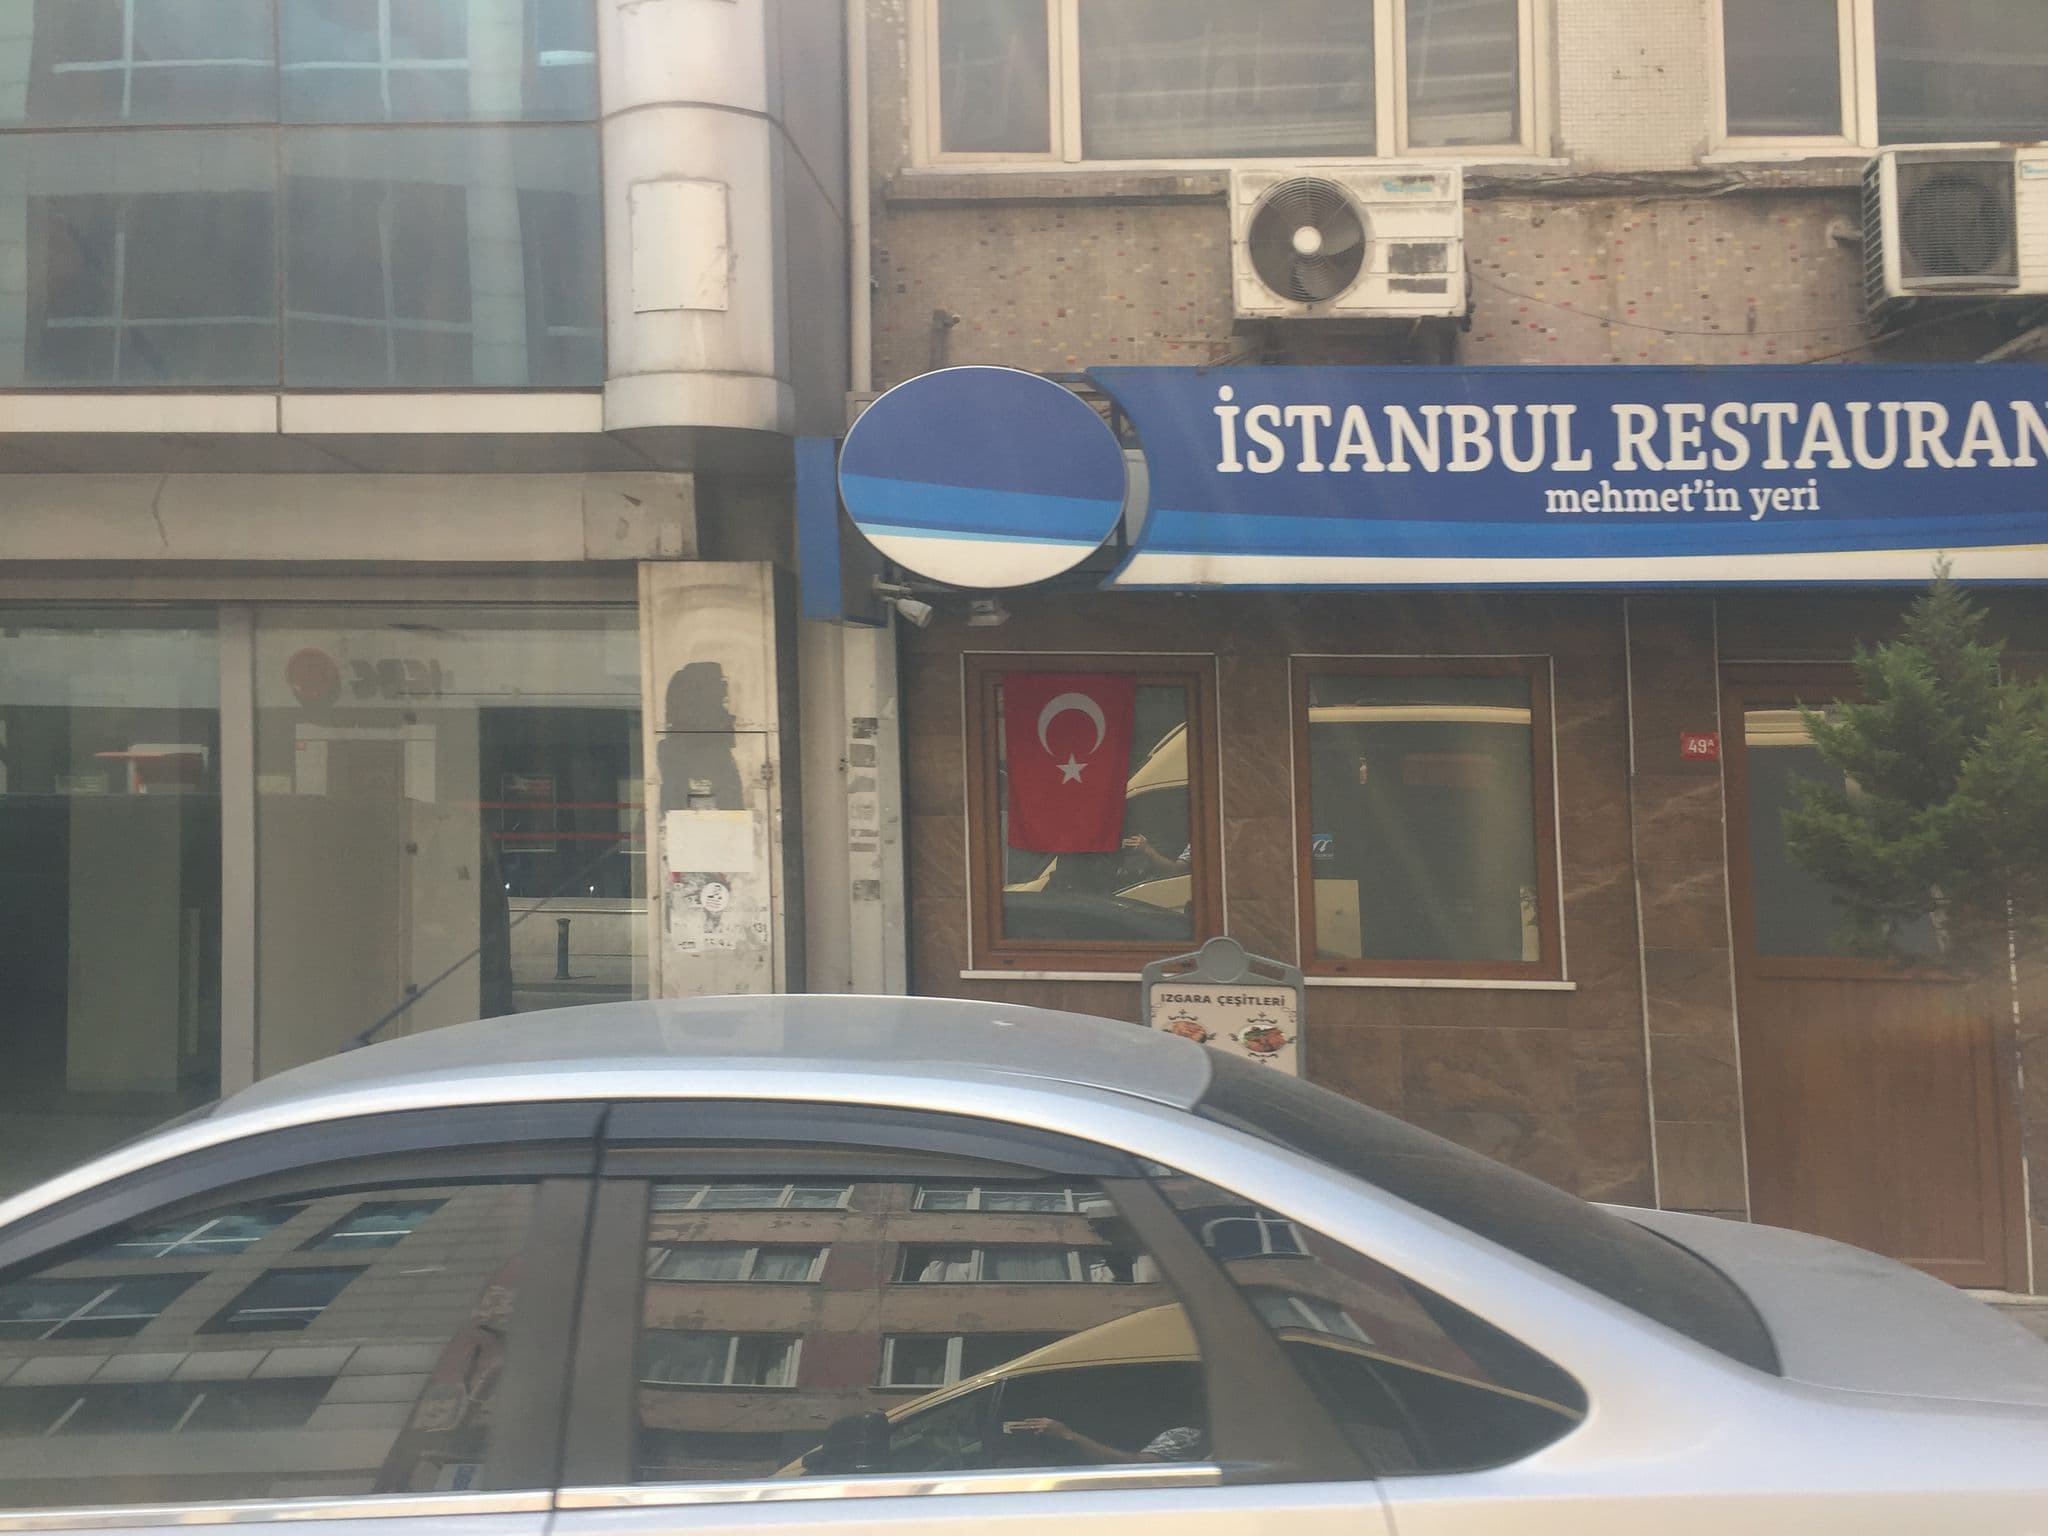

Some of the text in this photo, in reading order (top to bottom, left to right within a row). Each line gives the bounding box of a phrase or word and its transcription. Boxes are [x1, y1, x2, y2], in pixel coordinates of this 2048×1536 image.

[1213, 385, 1592, 474] İSTANBUL
[1749, 479, 1820, 520] yeri
[1161, 993, 1285, 1007] IZGARA ÇEŞİTLERİ
